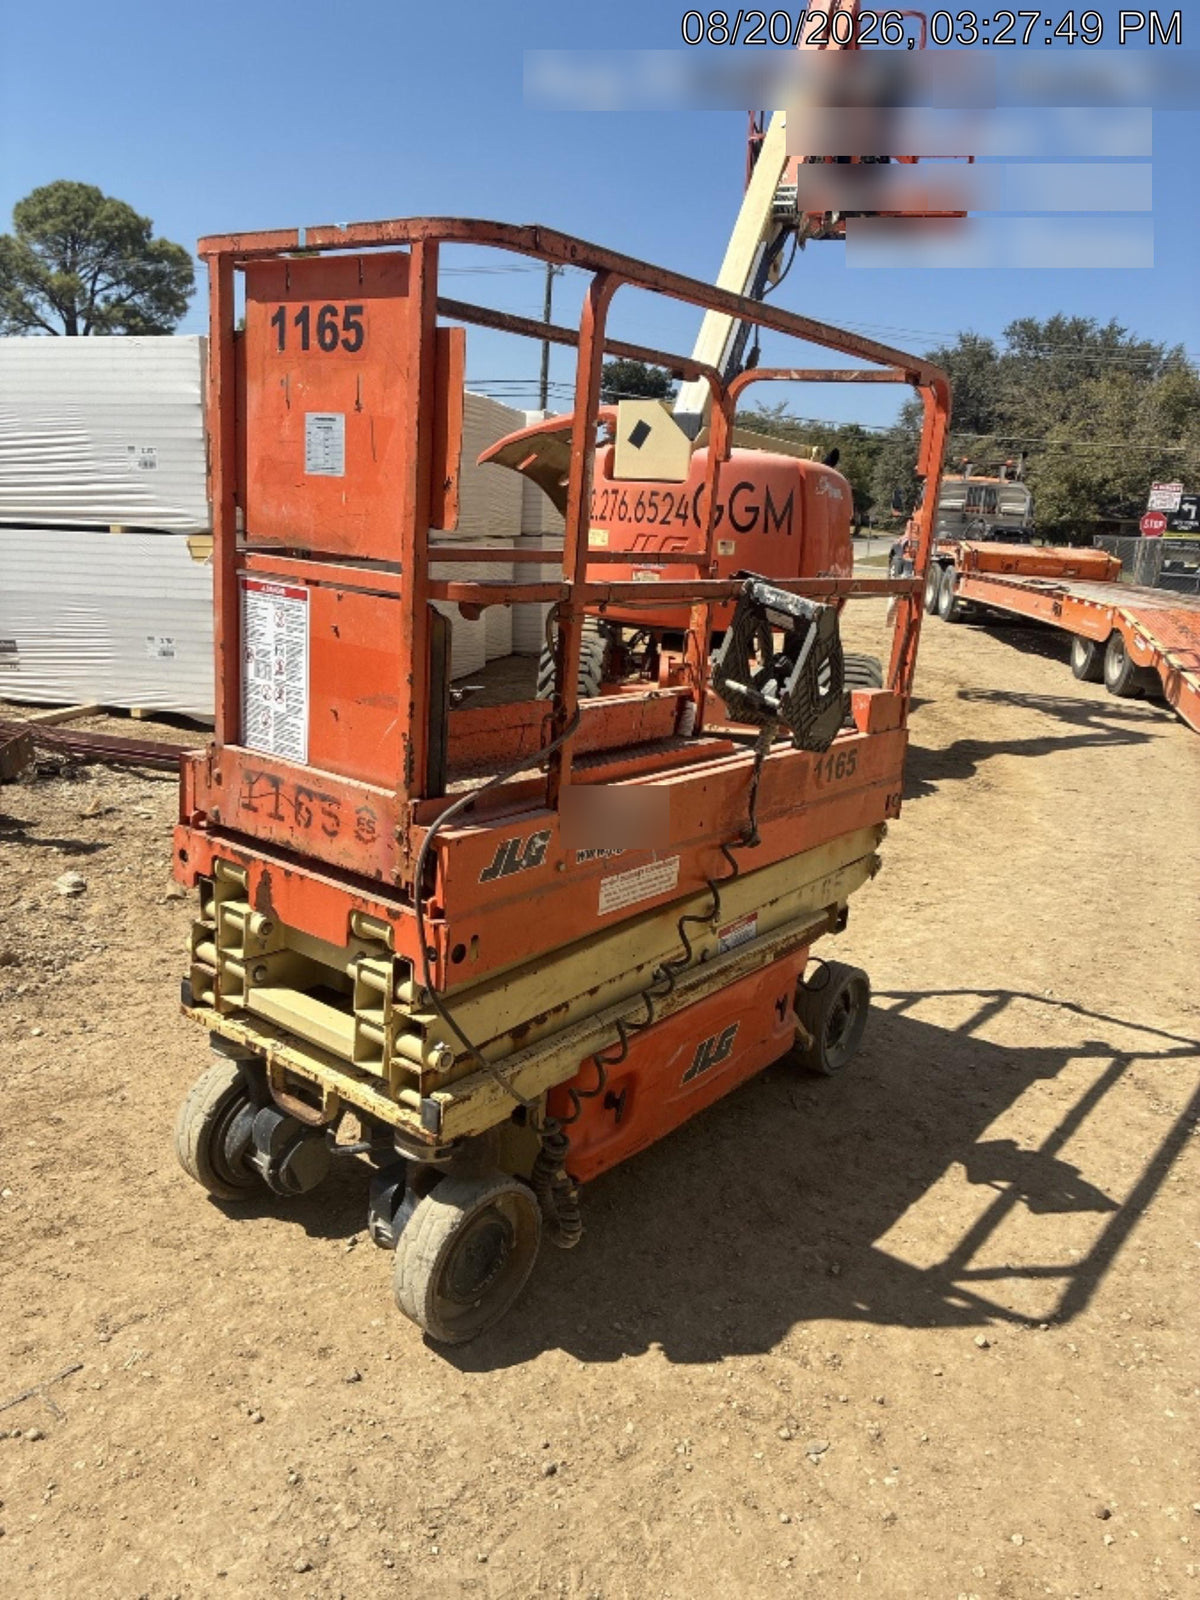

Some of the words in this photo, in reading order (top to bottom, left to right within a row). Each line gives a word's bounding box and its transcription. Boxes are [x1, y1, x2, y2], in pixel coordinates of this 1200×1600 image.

[271, 304, 364, 352] 1165
[1143, 518, 1164, 529] STOP
[814, 748, 858, 787] 1165
[478, 829, 552, 883] JLG
[679, 1020, 740, 1088] JLG
